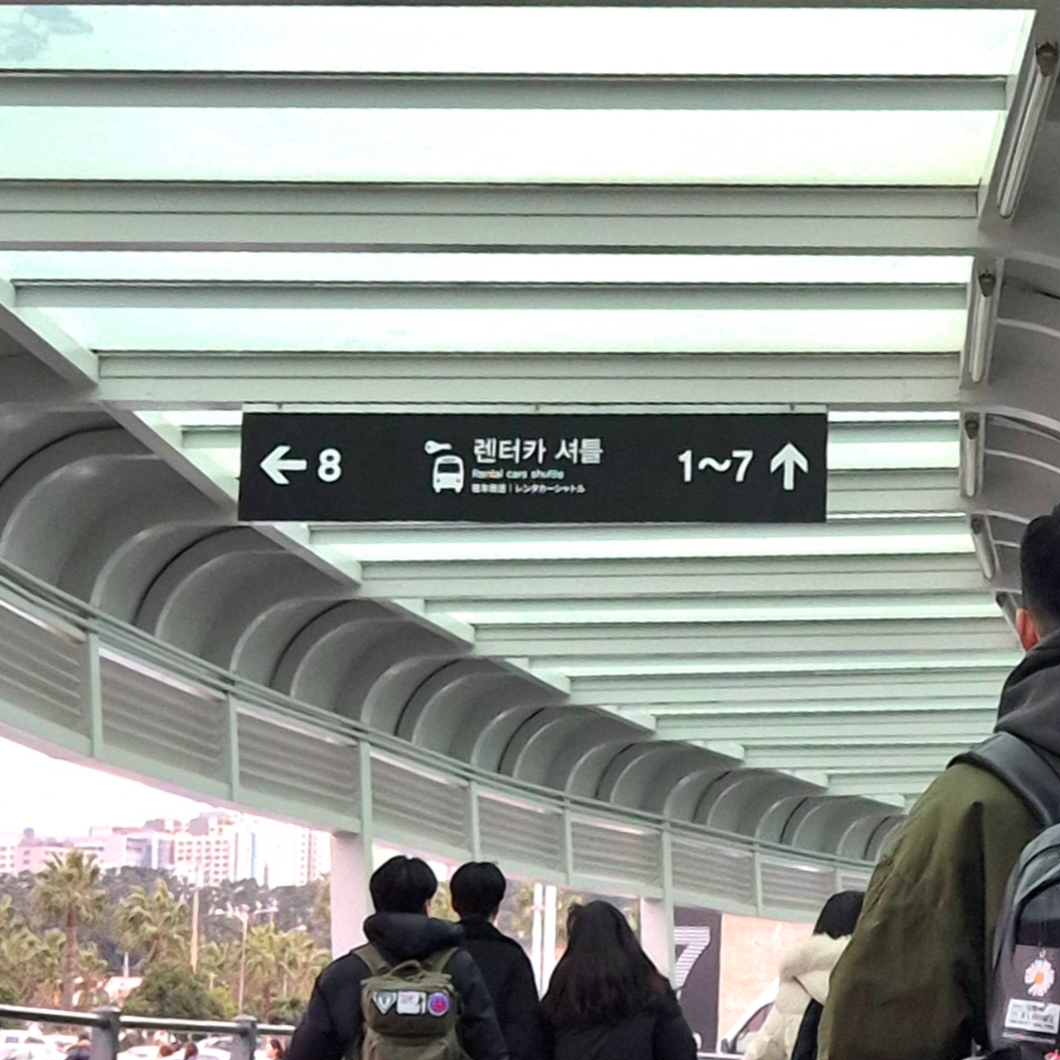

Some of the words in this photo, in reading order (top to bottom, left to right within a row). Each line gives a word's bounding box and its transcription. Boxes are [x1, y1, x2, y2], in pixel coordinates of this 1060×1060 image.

[473, 438, 547, 464] 렌터카
[555, 438, 604, 464] 셔틀
[316, 447, 343, 484] 8
[472, 469, 504, 480] Rental
